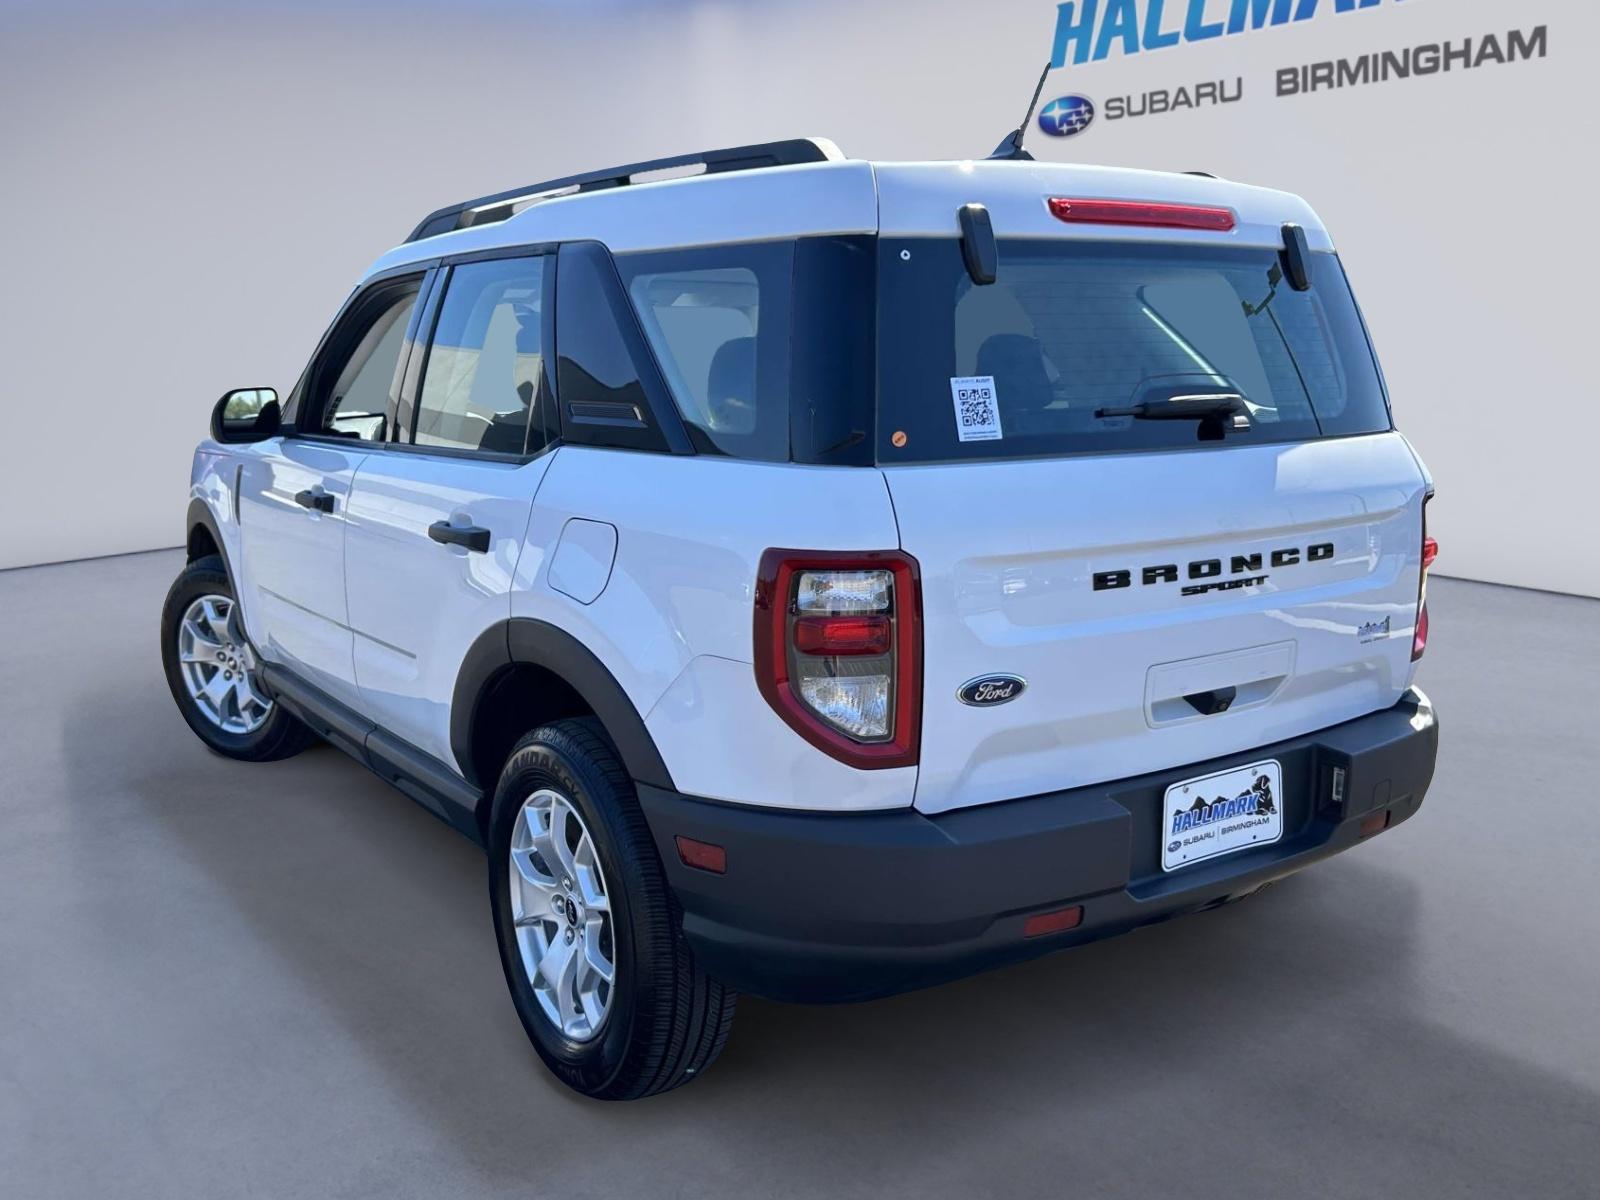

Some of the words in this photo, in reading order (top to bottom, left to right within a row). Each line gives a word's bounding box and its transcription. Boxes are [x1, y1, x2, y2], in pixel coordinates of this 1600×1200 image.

[1050, 0, 1386, 69] HALLM
[1103, 77, 1243, 120] SUBARU
[1275, 25, 1547, 97] BIRMINGHAM
[1092, 542, 1334, 591] BRONCO
[1180, 575, 1269, 596] SPORT
[975, 681, 1013, 701] Ford
[1171, 793, 1260, 834] HALLMARK
[1183, 831, 1215, 847] SUBARU
[1221, 817, 1270, 836] BIRMINGHAM
